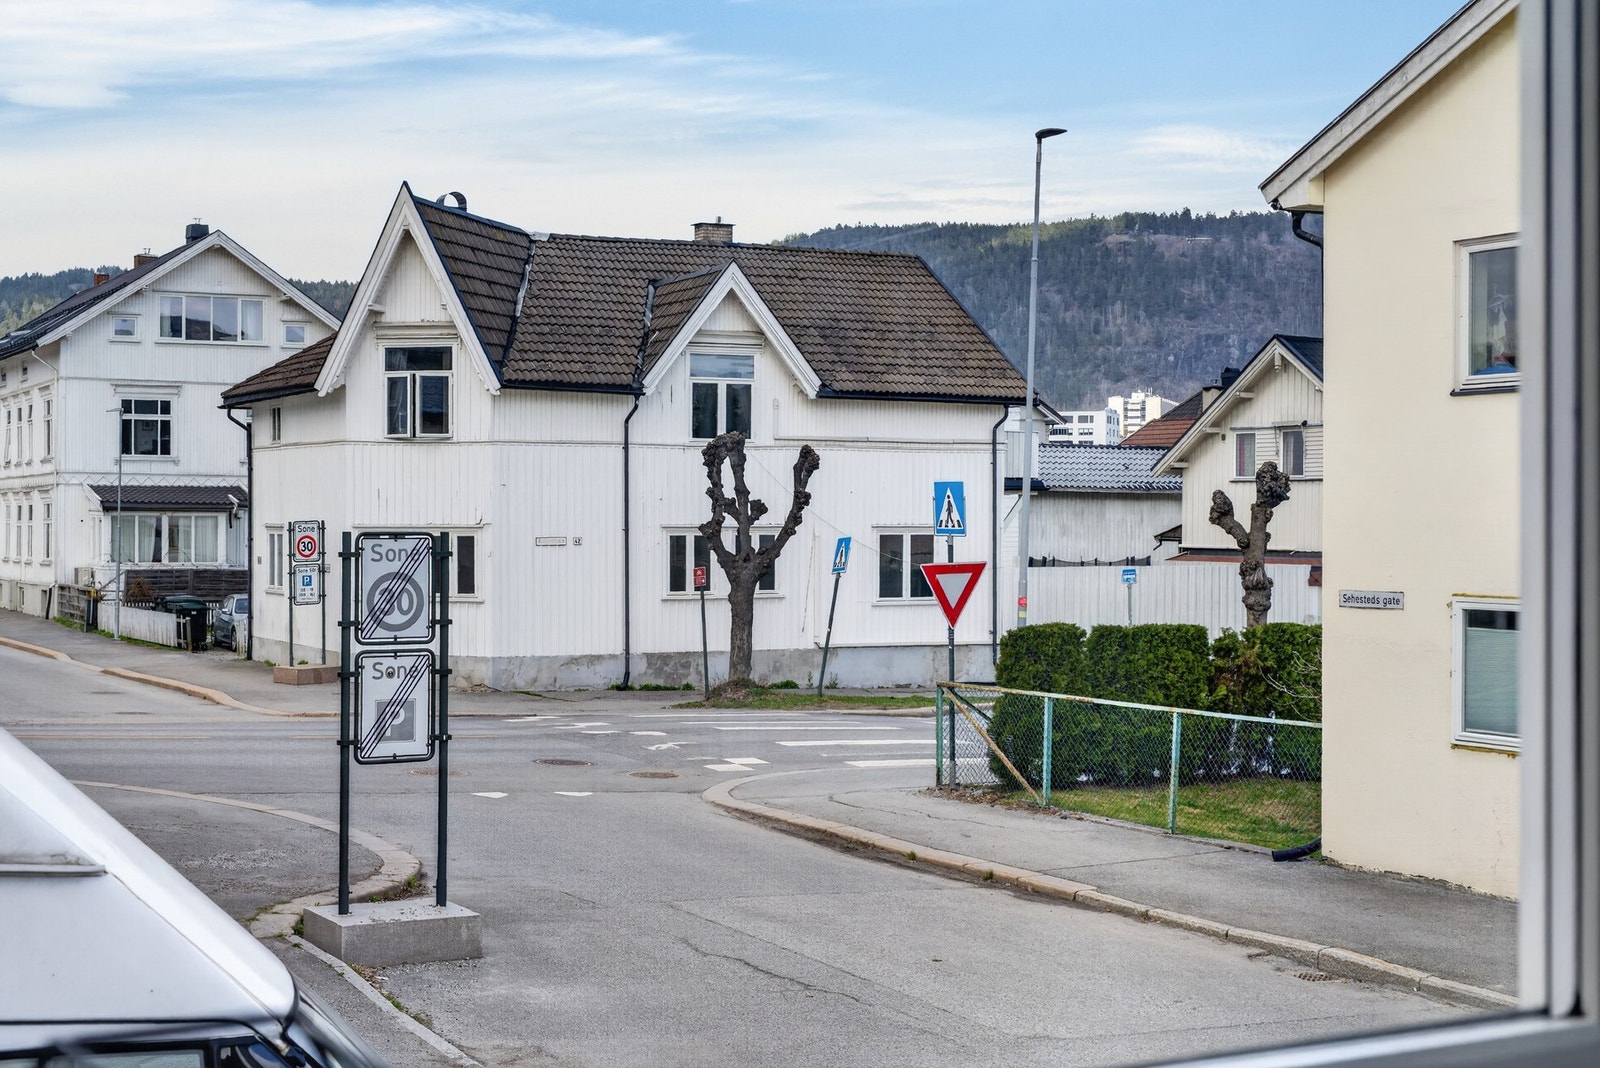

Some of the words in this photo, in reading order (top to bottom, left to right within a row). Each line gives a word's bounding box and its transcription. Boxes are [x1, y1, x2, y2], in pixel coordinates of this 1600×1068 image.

[298, 525, 315, 533] Sone
[300, 541, 313, 552] 30
[304, 576, 310, 585] P
[378, 587, 414, 616] 30
[1343, 594, 1380, 605] Sehesteds
[1382, 596, 1400, 607] gate
